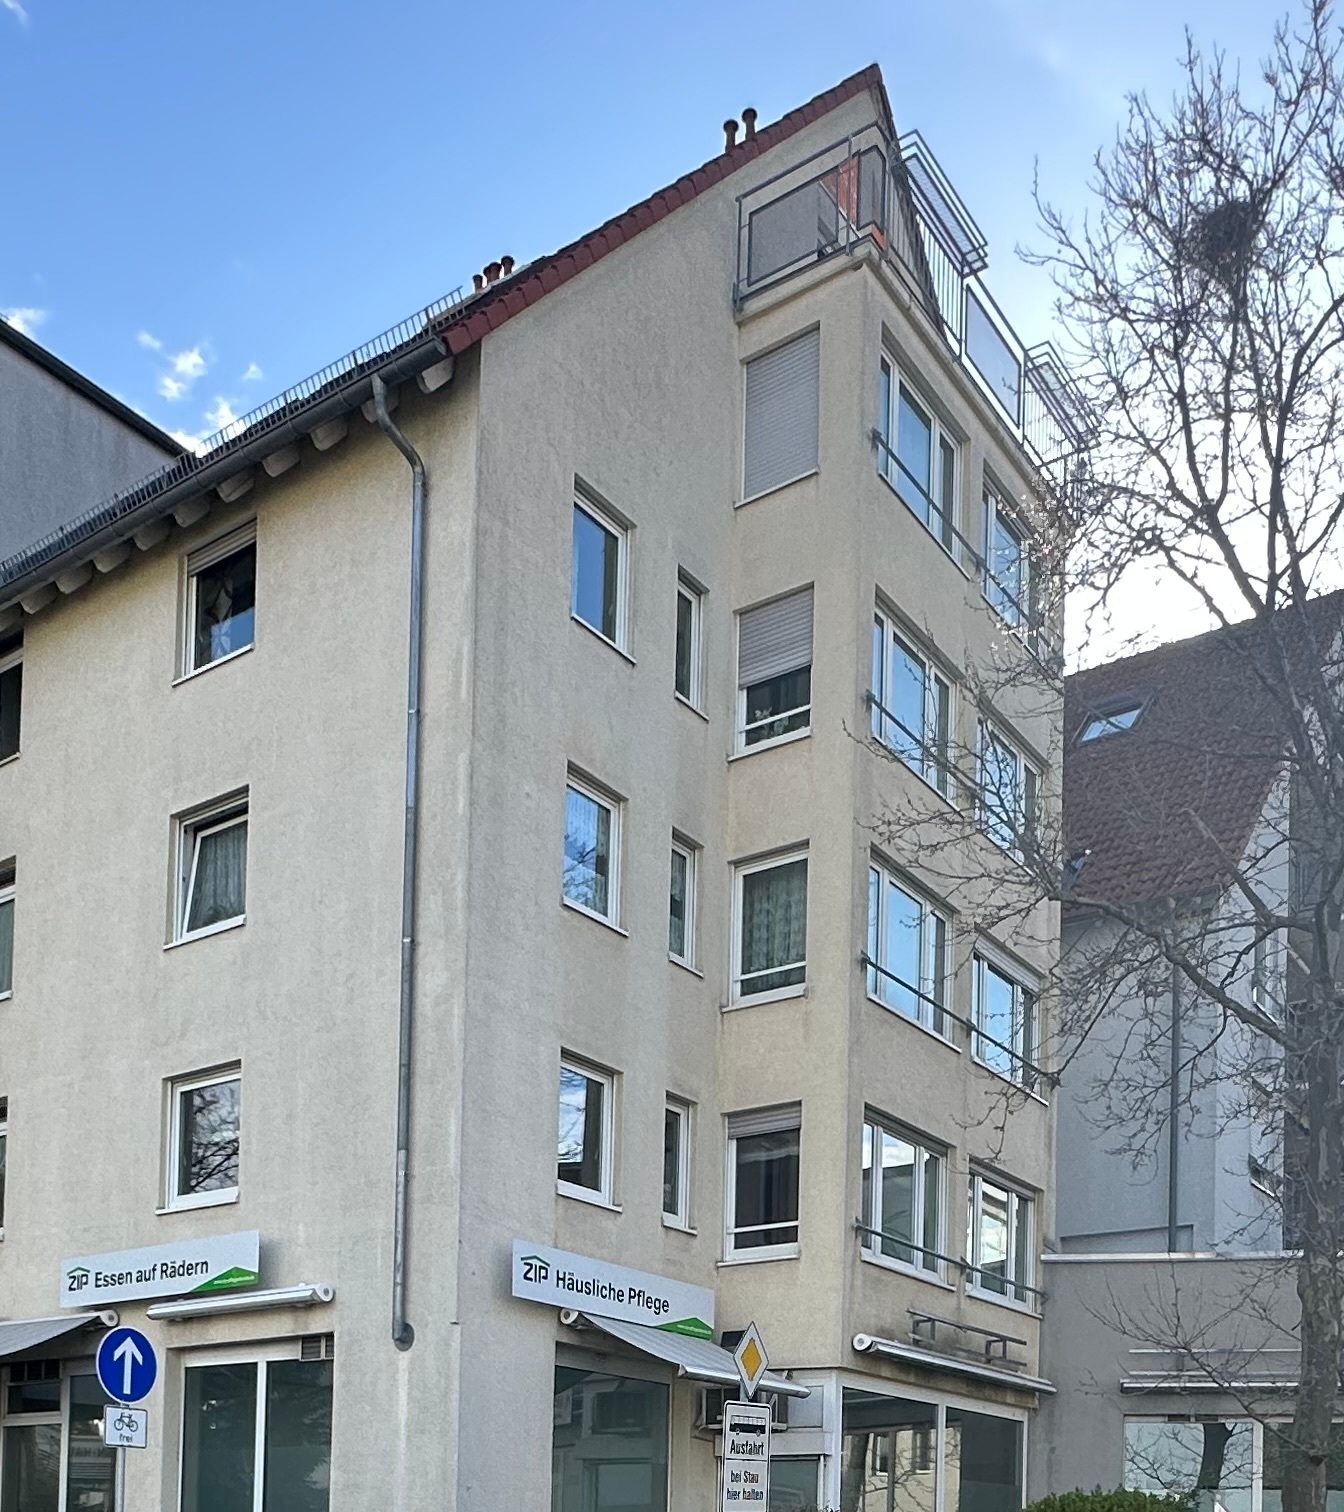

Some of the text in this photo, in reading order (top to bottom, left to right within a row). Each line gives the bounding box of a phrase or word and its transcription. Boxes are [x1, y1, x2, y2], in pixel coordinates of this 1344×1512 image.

[68, 1274, 89, 1292] ZIP
[94, 1271, 133, 1288] Essen
[136, 1264, 157, 1283] auf
[160, 1260, 209, 1280] Rädern
[523, 1261, 670, 1315] ZIP Häusliche Pflege
[730, 1439, 764, 1456] Ausfahrt
[731, 1470, 759, 1484] bei Stau
[727, 1488, 764, 1501] hier halten
